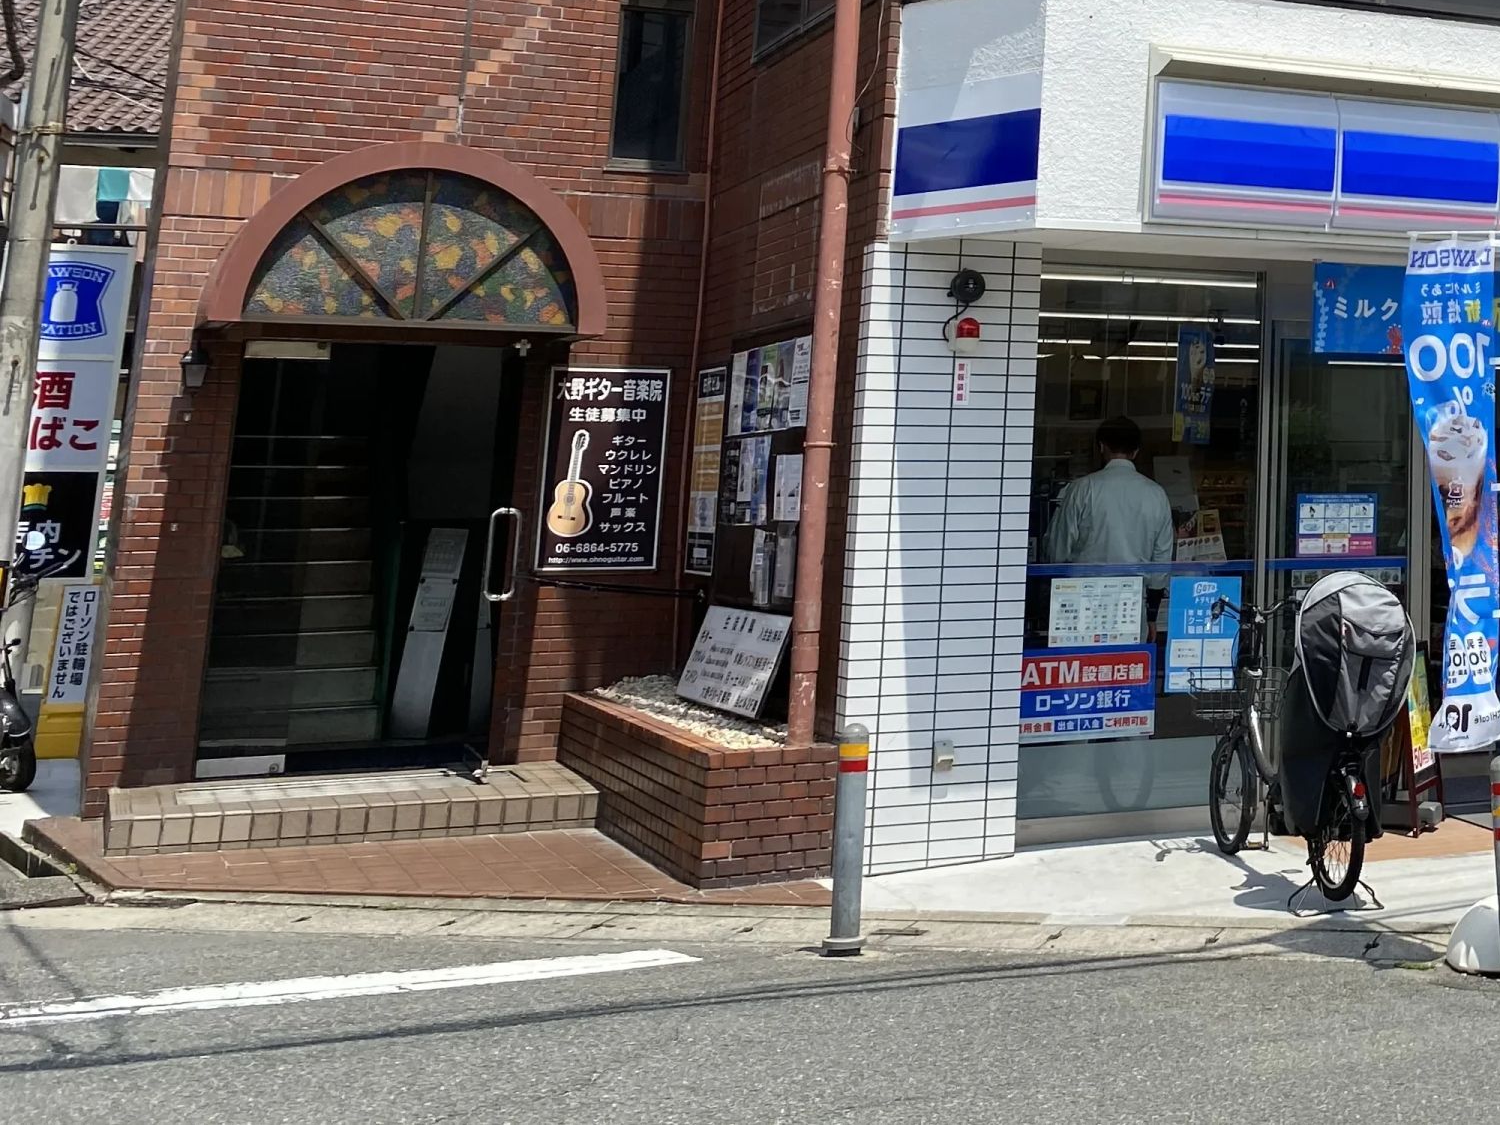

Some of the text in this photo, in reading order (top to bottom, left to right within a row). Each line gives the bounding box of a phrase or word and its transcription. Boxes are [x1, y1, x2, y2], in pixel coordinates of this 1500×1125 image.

[48, 266, 106, 283] AWSON
[557, 377, 663, 402] 大野ギター音楽院
[568, 407, 646, 422] 生徒募集中
[30, 416, 99, 451] ばこ
[612, 435, 647, 446] ギター
[605, 449, 651, 461] ウクレレ
[598, 464, 656, 475] マンドリン
[609, 478, 643, 489] ピアノ
[602, 492, 648, 504] フルート
[599, 521, 646, 532] サックス
[555, 542, 639, 554] 06-6864-5775
[52, 592, 80, 699] ではございません
[69, 591, 97, 685] ローソン駐輪場
[1021, 660, 1144, 686] ATM設置店舗
[1035, 689, 1132, 712] ローソン銀行
[1020, 716, 1148, 734] 用金庫 出金 入金 ご利用可能
